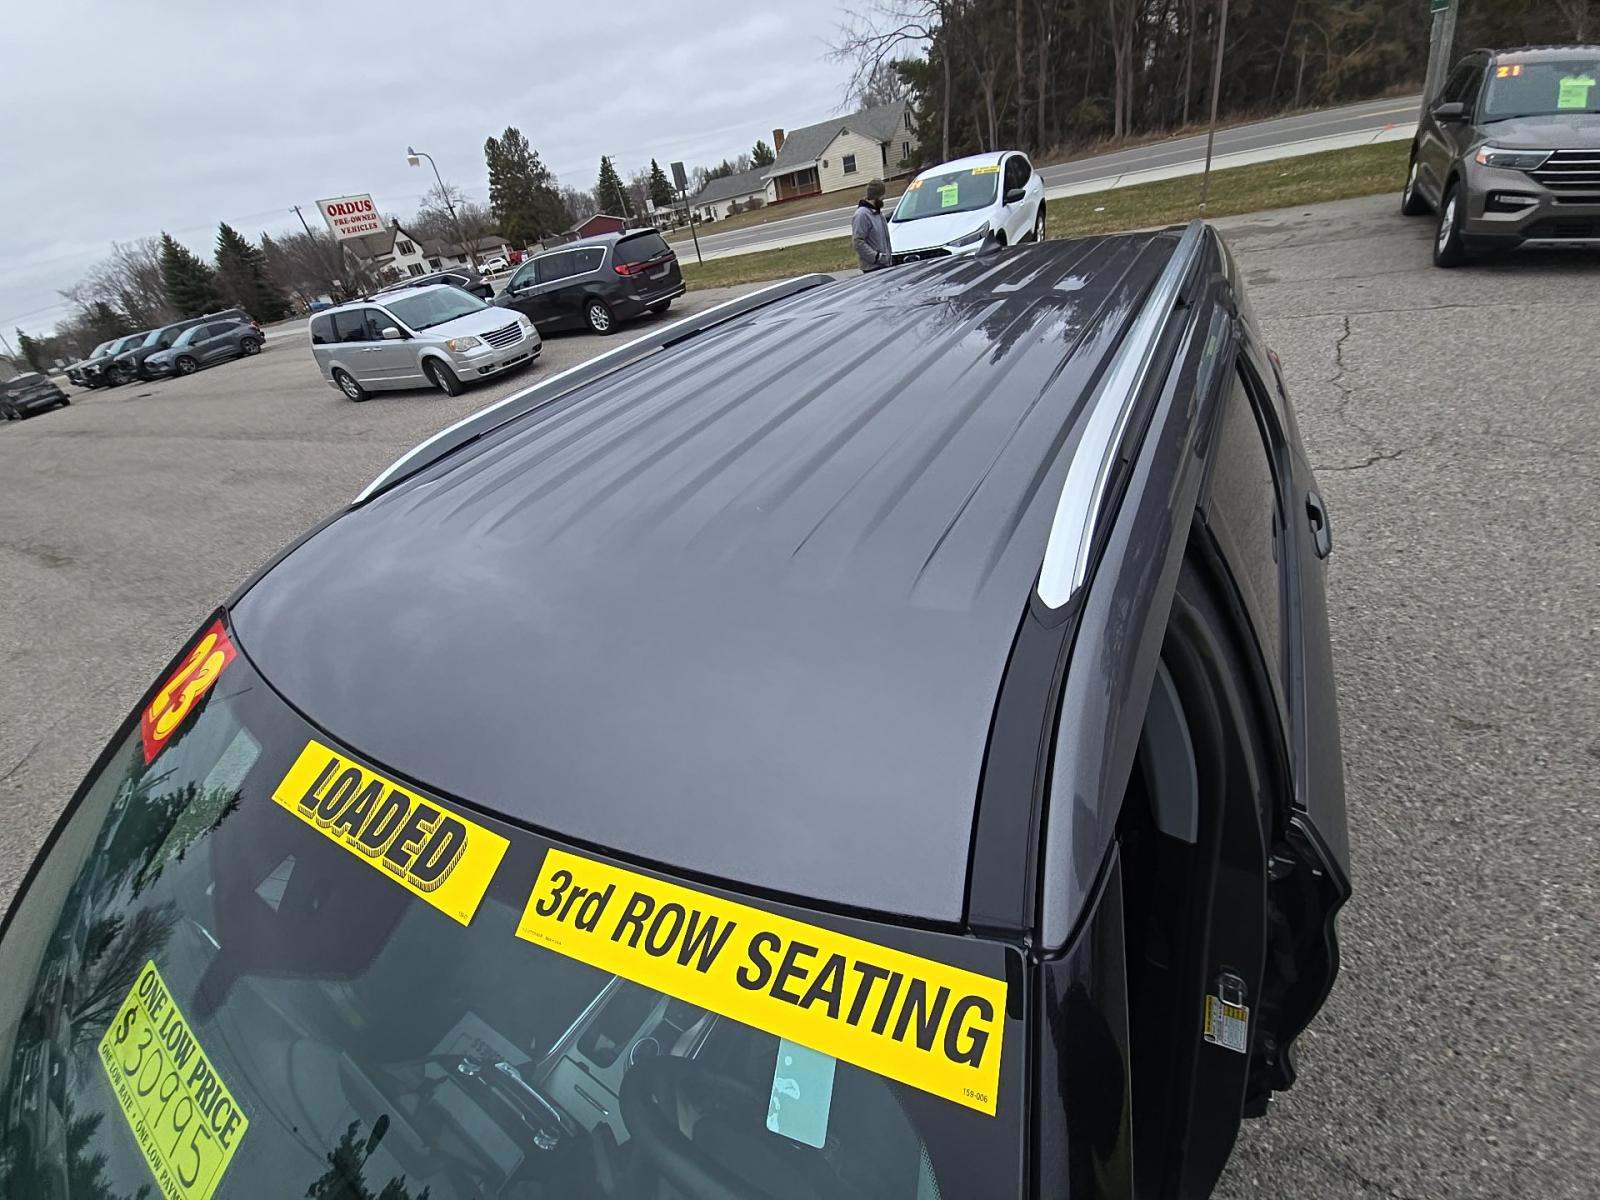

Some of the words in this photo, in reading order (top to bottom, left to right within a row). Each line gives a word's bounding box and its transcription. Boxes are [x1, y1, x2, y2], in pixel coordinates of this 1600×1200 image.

[1496, 65, 1520, 78] 21
[327, 200, 372, 217] ORDUS
[333, 213, 377, 226] PRE-OWNED
[341, 223, 378, 235] VEHICLES
[149, 633, 225, 741] 23
[298, 757, 468, 893] LOADED
[535, 869, 617, 934] 3rd
[610, 891, 738, 974] ROW
[736, 931, 994, 1069] SEATING
[138, 970, 169, 1024] ONE
[158, 1008, 197, 1070] LOW
[186, 1055, 242, 1150] PRICE
[109, 1061, 122, 1087] LOW
[118, 1083, 133, 1113] RATE
[136, 1120, 149, 1147] ONE
[147, 1142, 163, 1172] LOW
